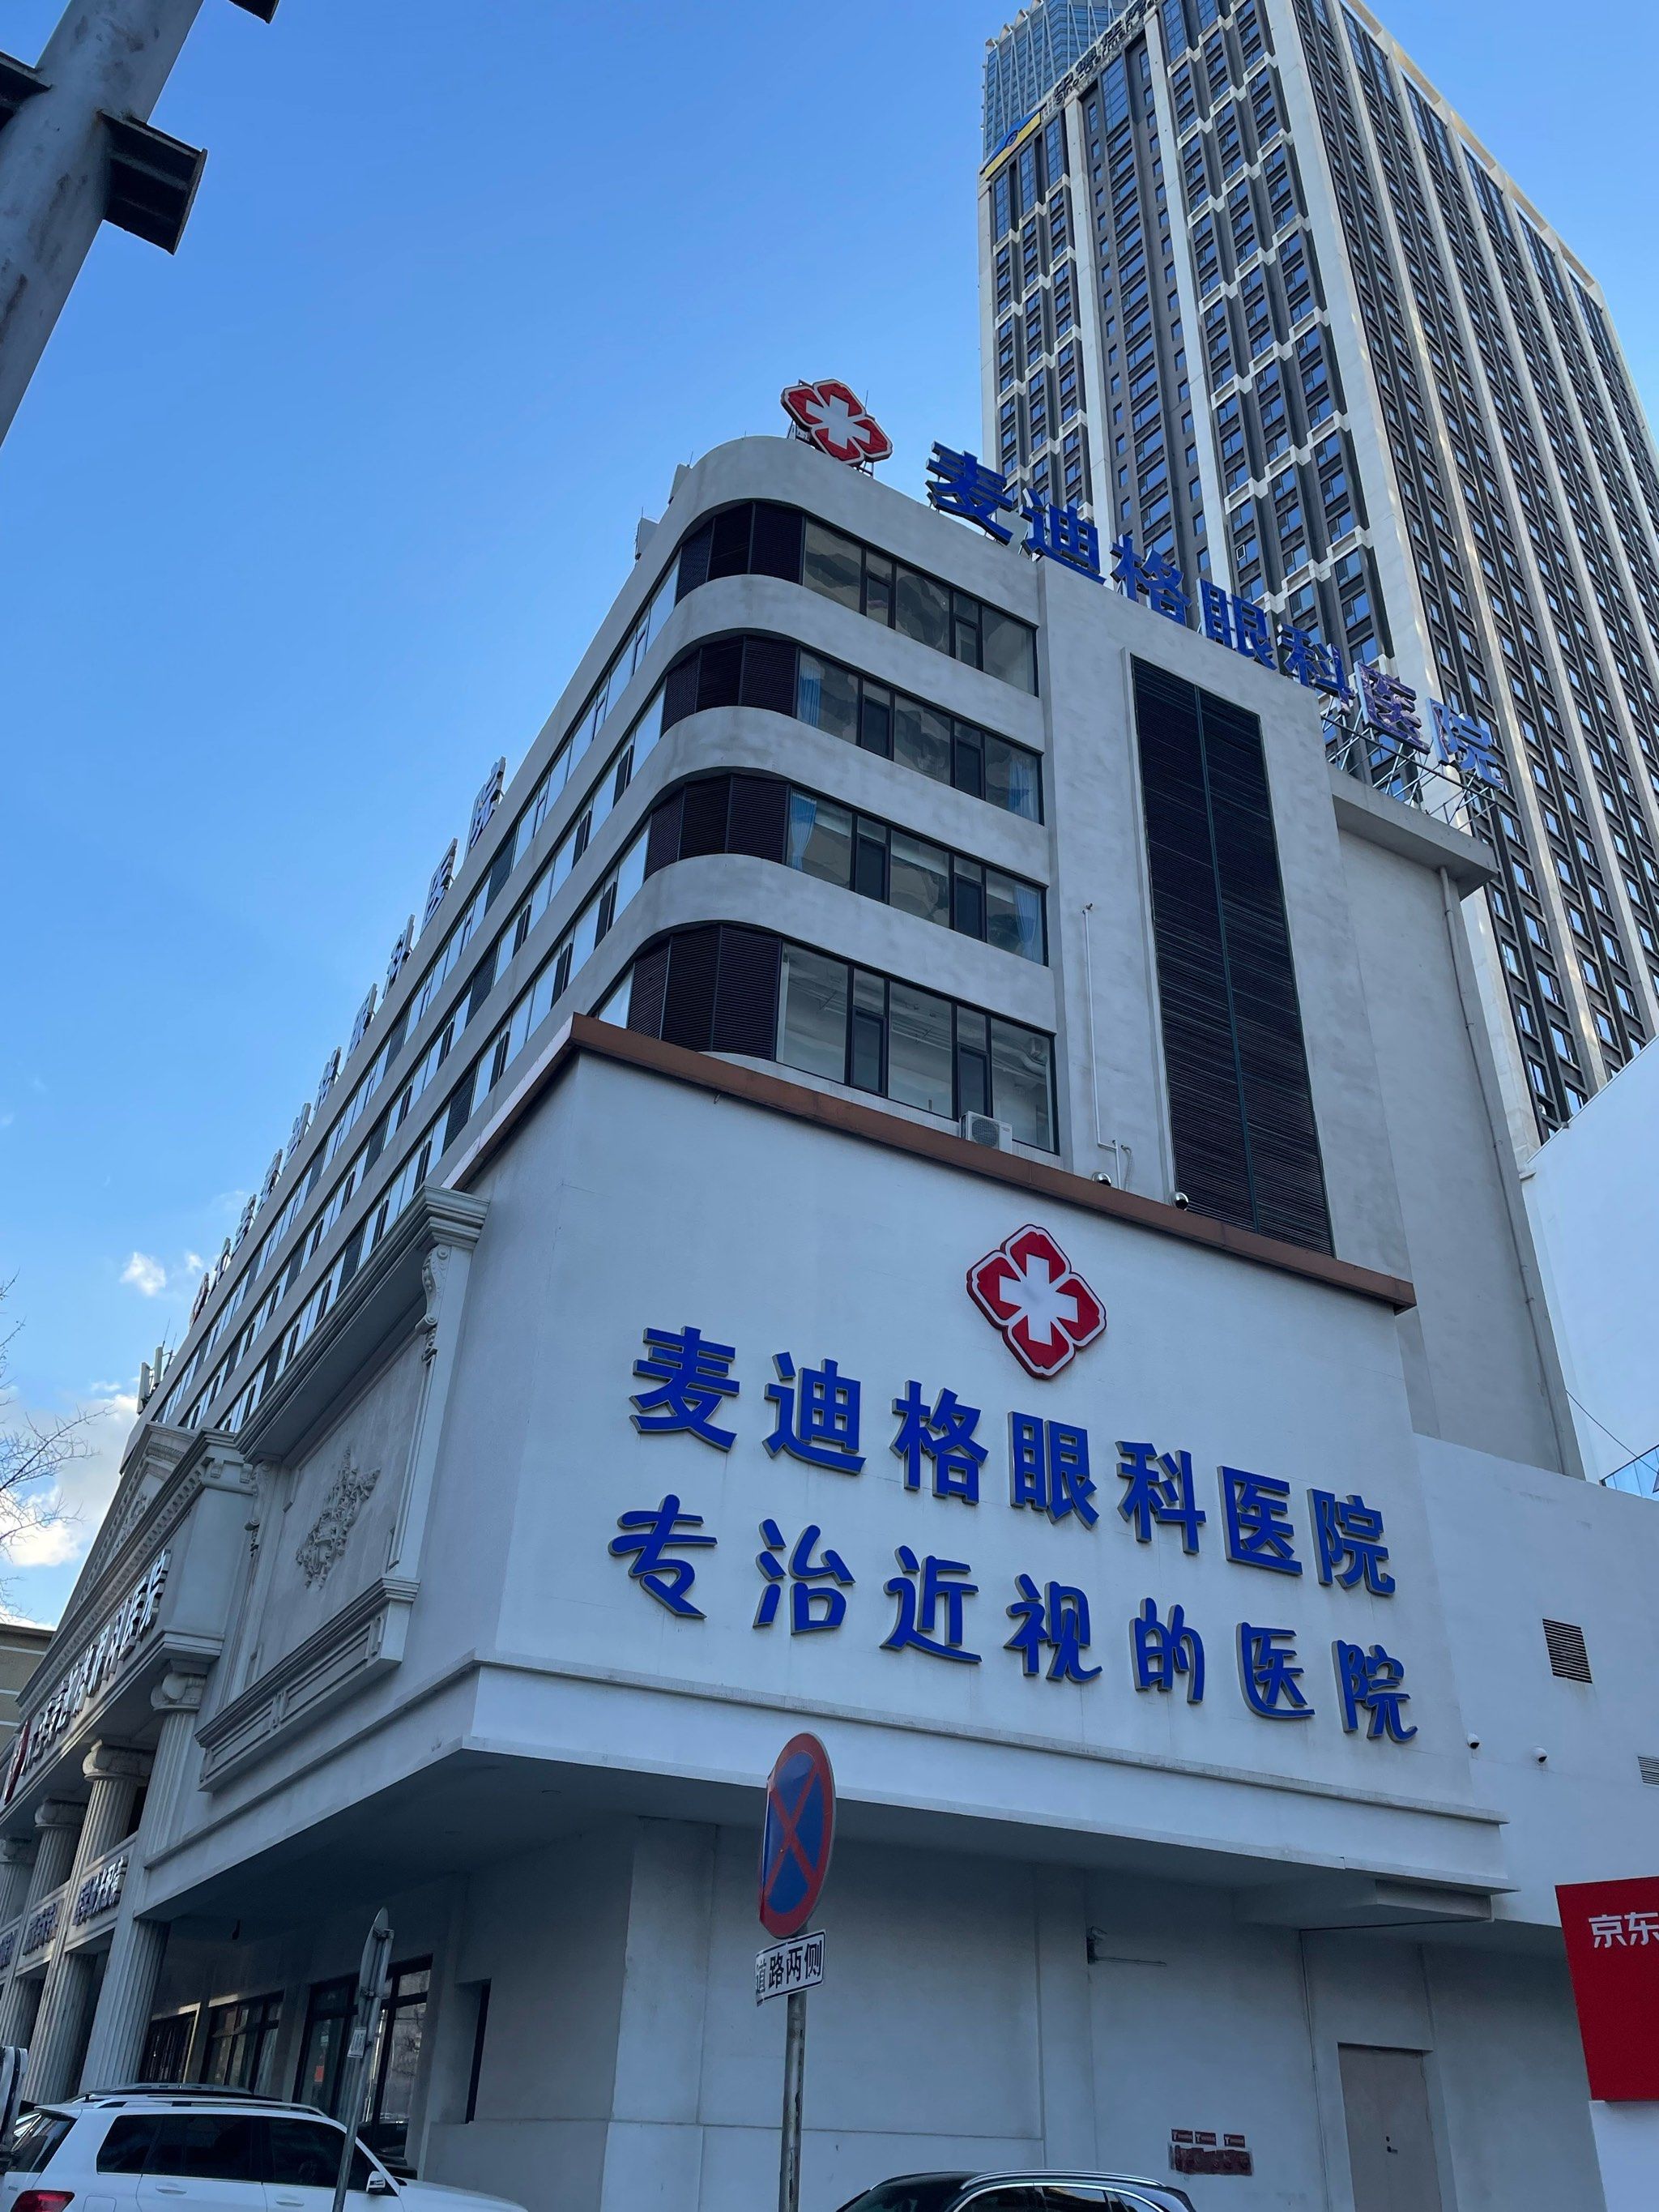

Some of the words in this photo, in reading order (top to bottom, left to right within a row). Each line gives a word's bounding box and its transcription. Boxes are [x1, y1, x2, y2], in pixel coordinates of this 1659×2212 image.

[925, 441, 1504, 789] 麦迪格眼科医院
[629, 1326, 1397, 1597] 麦迪格眼科医院
[608, 1493, 1418, 1743] 专治近视的医院
[1589, 1912, 1659, 1948] 京东
